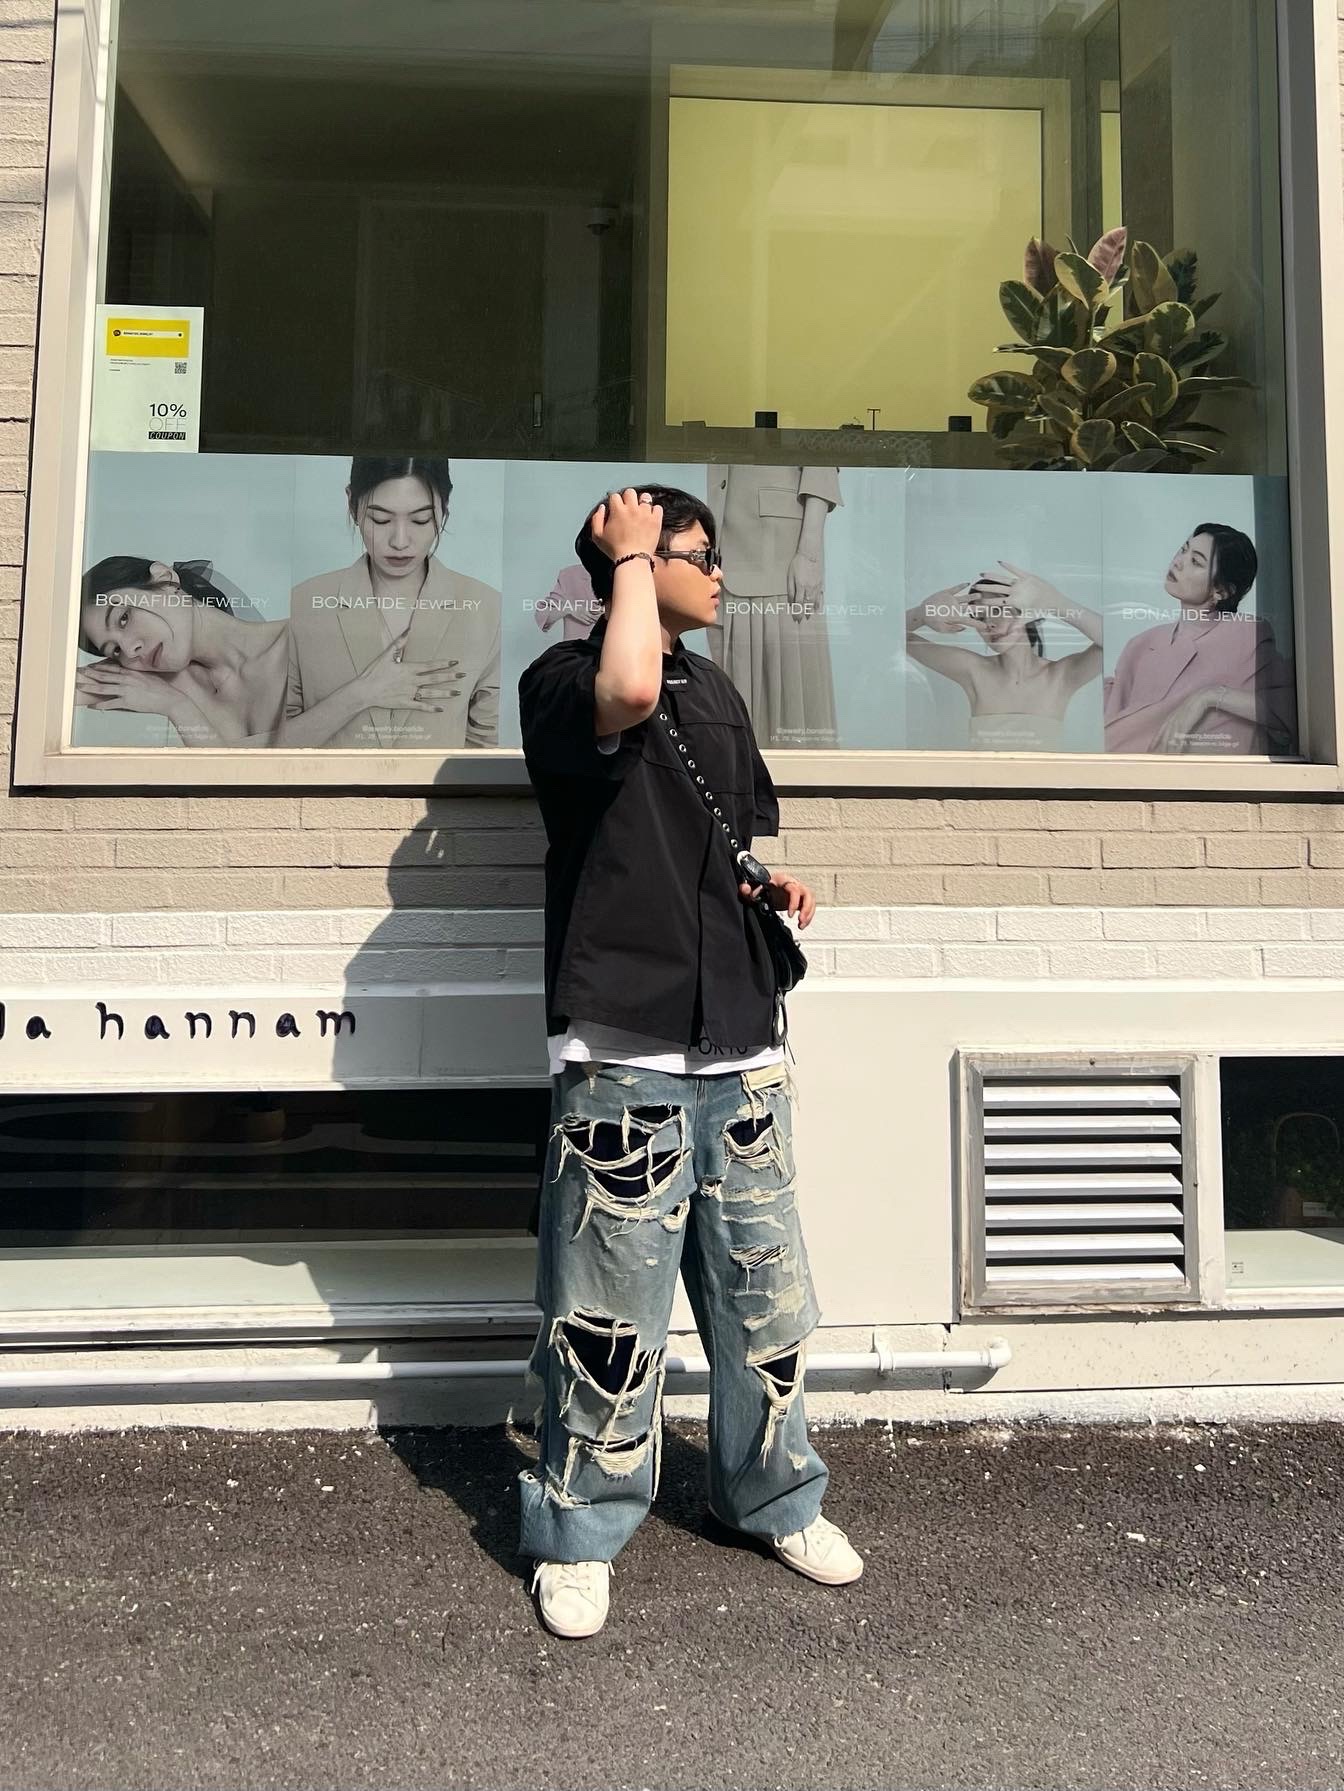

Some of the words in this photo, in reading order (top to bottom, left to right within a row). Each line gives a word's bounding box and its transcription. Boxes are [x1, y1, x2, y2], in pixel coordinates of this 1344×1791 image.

[149, 403, 187, 418] 10%
[149, 417, 186, 431] OFF
[149, 432, 186, 440] COUPON
[95, 593, 193, 608] BONAFIDE
[196, 596, 270, 609] JEWELRY
[311, 596, 406, 610] BONAFIDE
[410, 599, 482, 611] JEWELRY
[522, 598, 605, 612] BONAFID
[725, 602, 814, 615] BONAFIDE
[818, 604, 886, 616] JEWELRY
[925, 604, 1013, 618] BONAFIDE
[1017, 607, 1083, 620] JEWELRY
[1122, 607, 1210, 621] BONAFIDE
[95, 1001, 356, 1040] hannam
